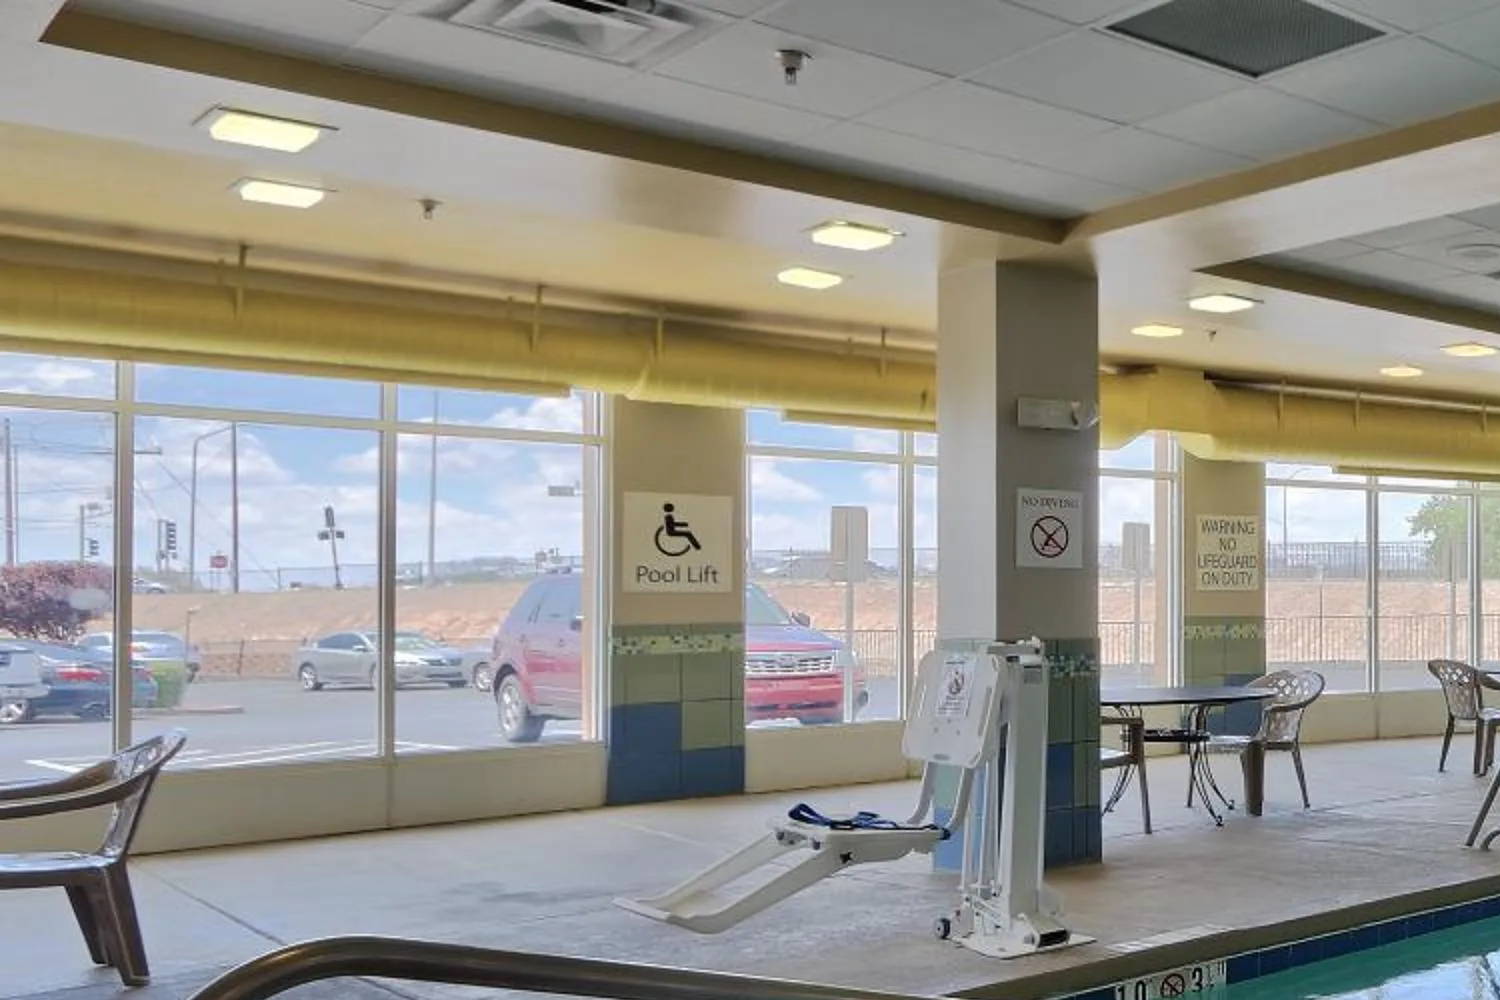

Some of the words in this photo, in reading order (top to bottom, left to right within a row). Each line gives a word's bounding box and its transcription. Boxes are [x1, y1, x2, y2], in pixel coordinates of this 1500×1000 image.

[1201, 519, 1256, 534] WARNING
[1219, 537, 1237, 550] NO
[1197, 552, 1257, 568] LIFEGUARD
[635, 565, 681, 584] Pool
[686, 565, 719, 584] Lift
[1201, 571, 1219, 585] ON
[1221, 571, 1252, 585] DUTY
